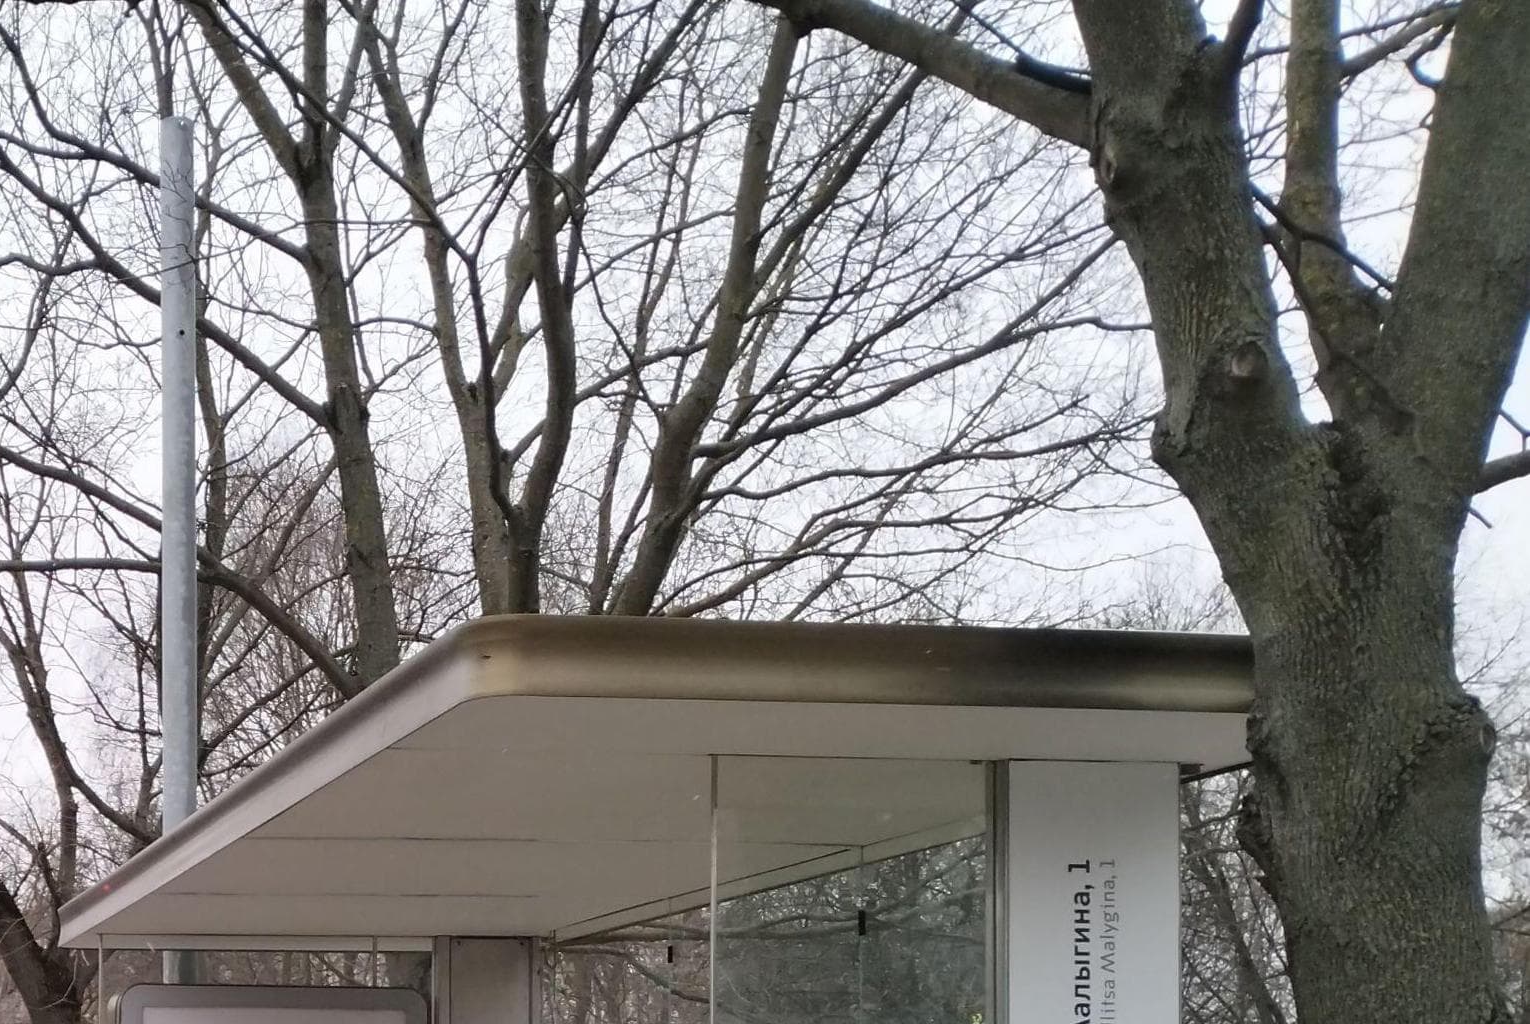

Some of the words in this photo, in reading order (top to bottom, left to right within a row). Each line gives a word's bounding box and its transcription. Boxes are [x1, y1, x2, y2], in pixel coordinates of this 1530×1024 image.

[1068, 859, 1090, 874] 1
[1100, 858, 1116, 869] 1
[1100, 875, 1120, 974] Malygina,
